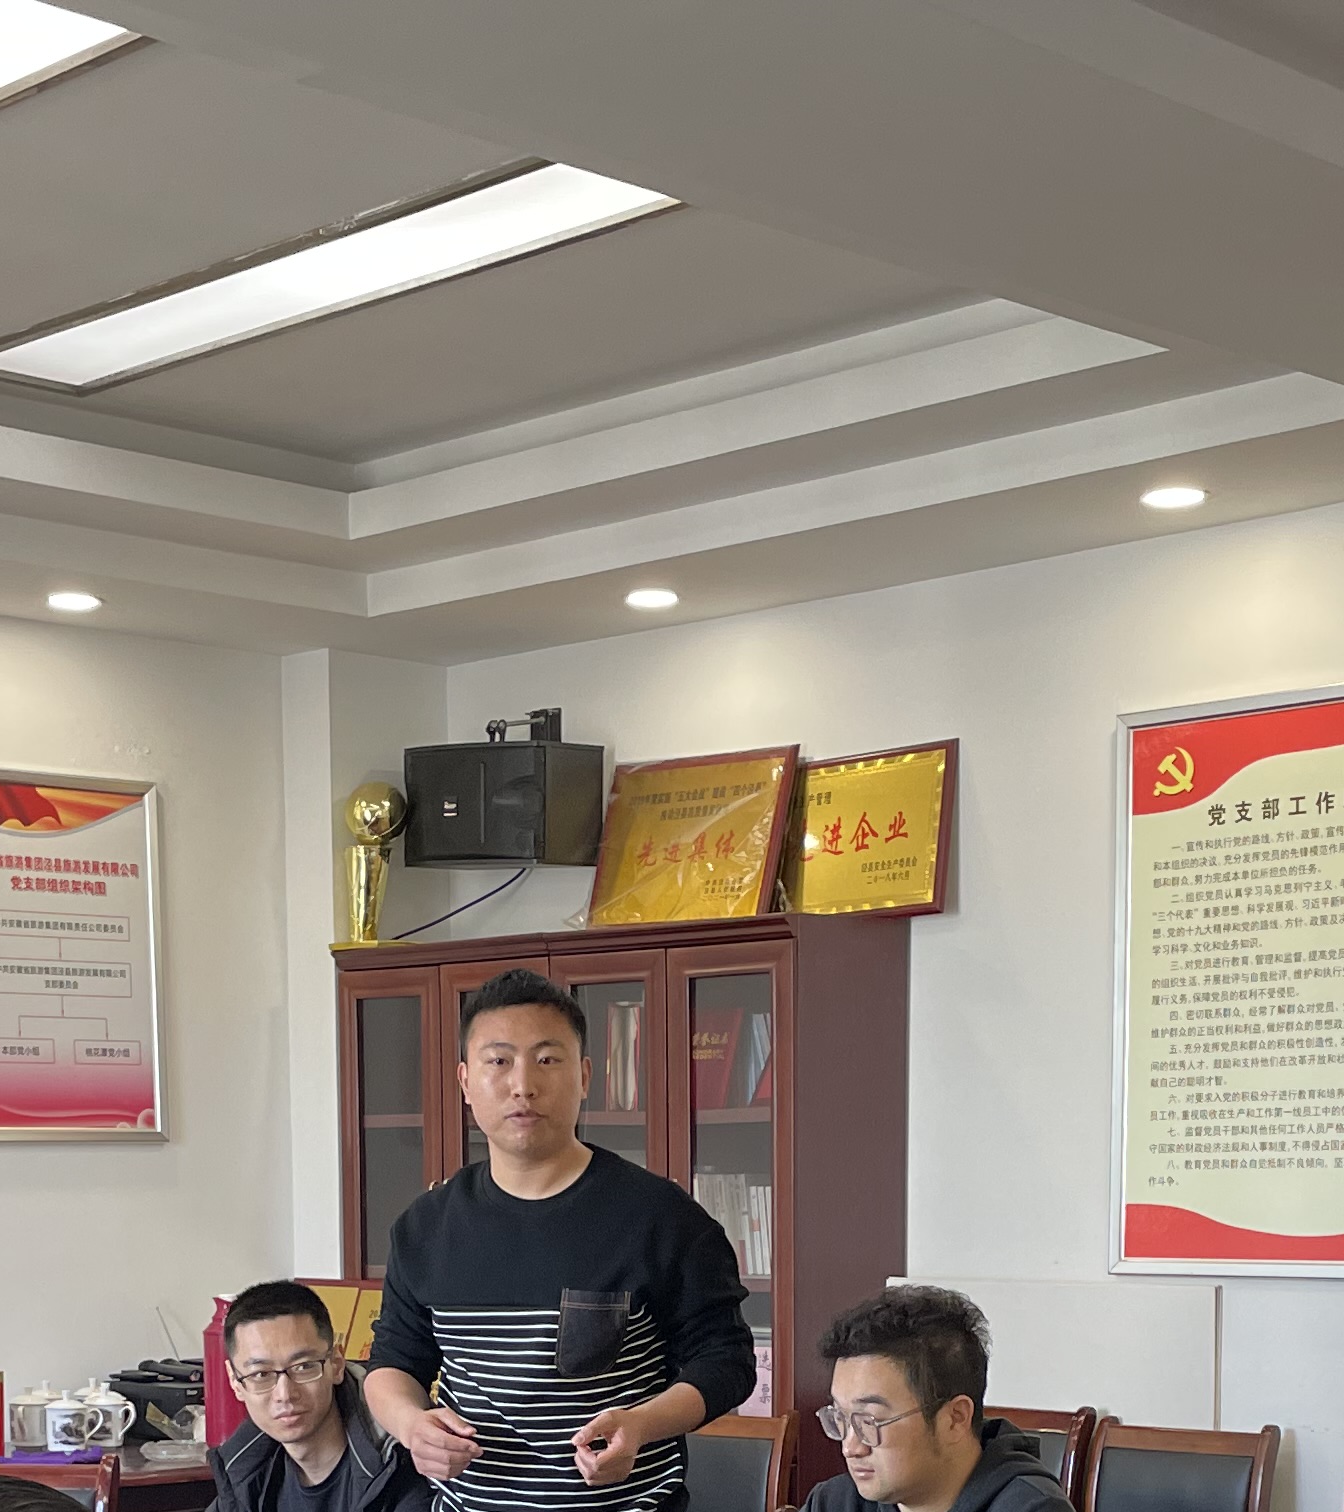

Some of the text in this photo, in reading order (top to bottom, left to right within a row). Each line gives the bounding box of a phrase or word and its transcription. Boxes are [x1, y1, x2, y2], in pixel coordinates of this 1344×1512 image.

[10, 875, 107, 896] 党支部组织架构图
